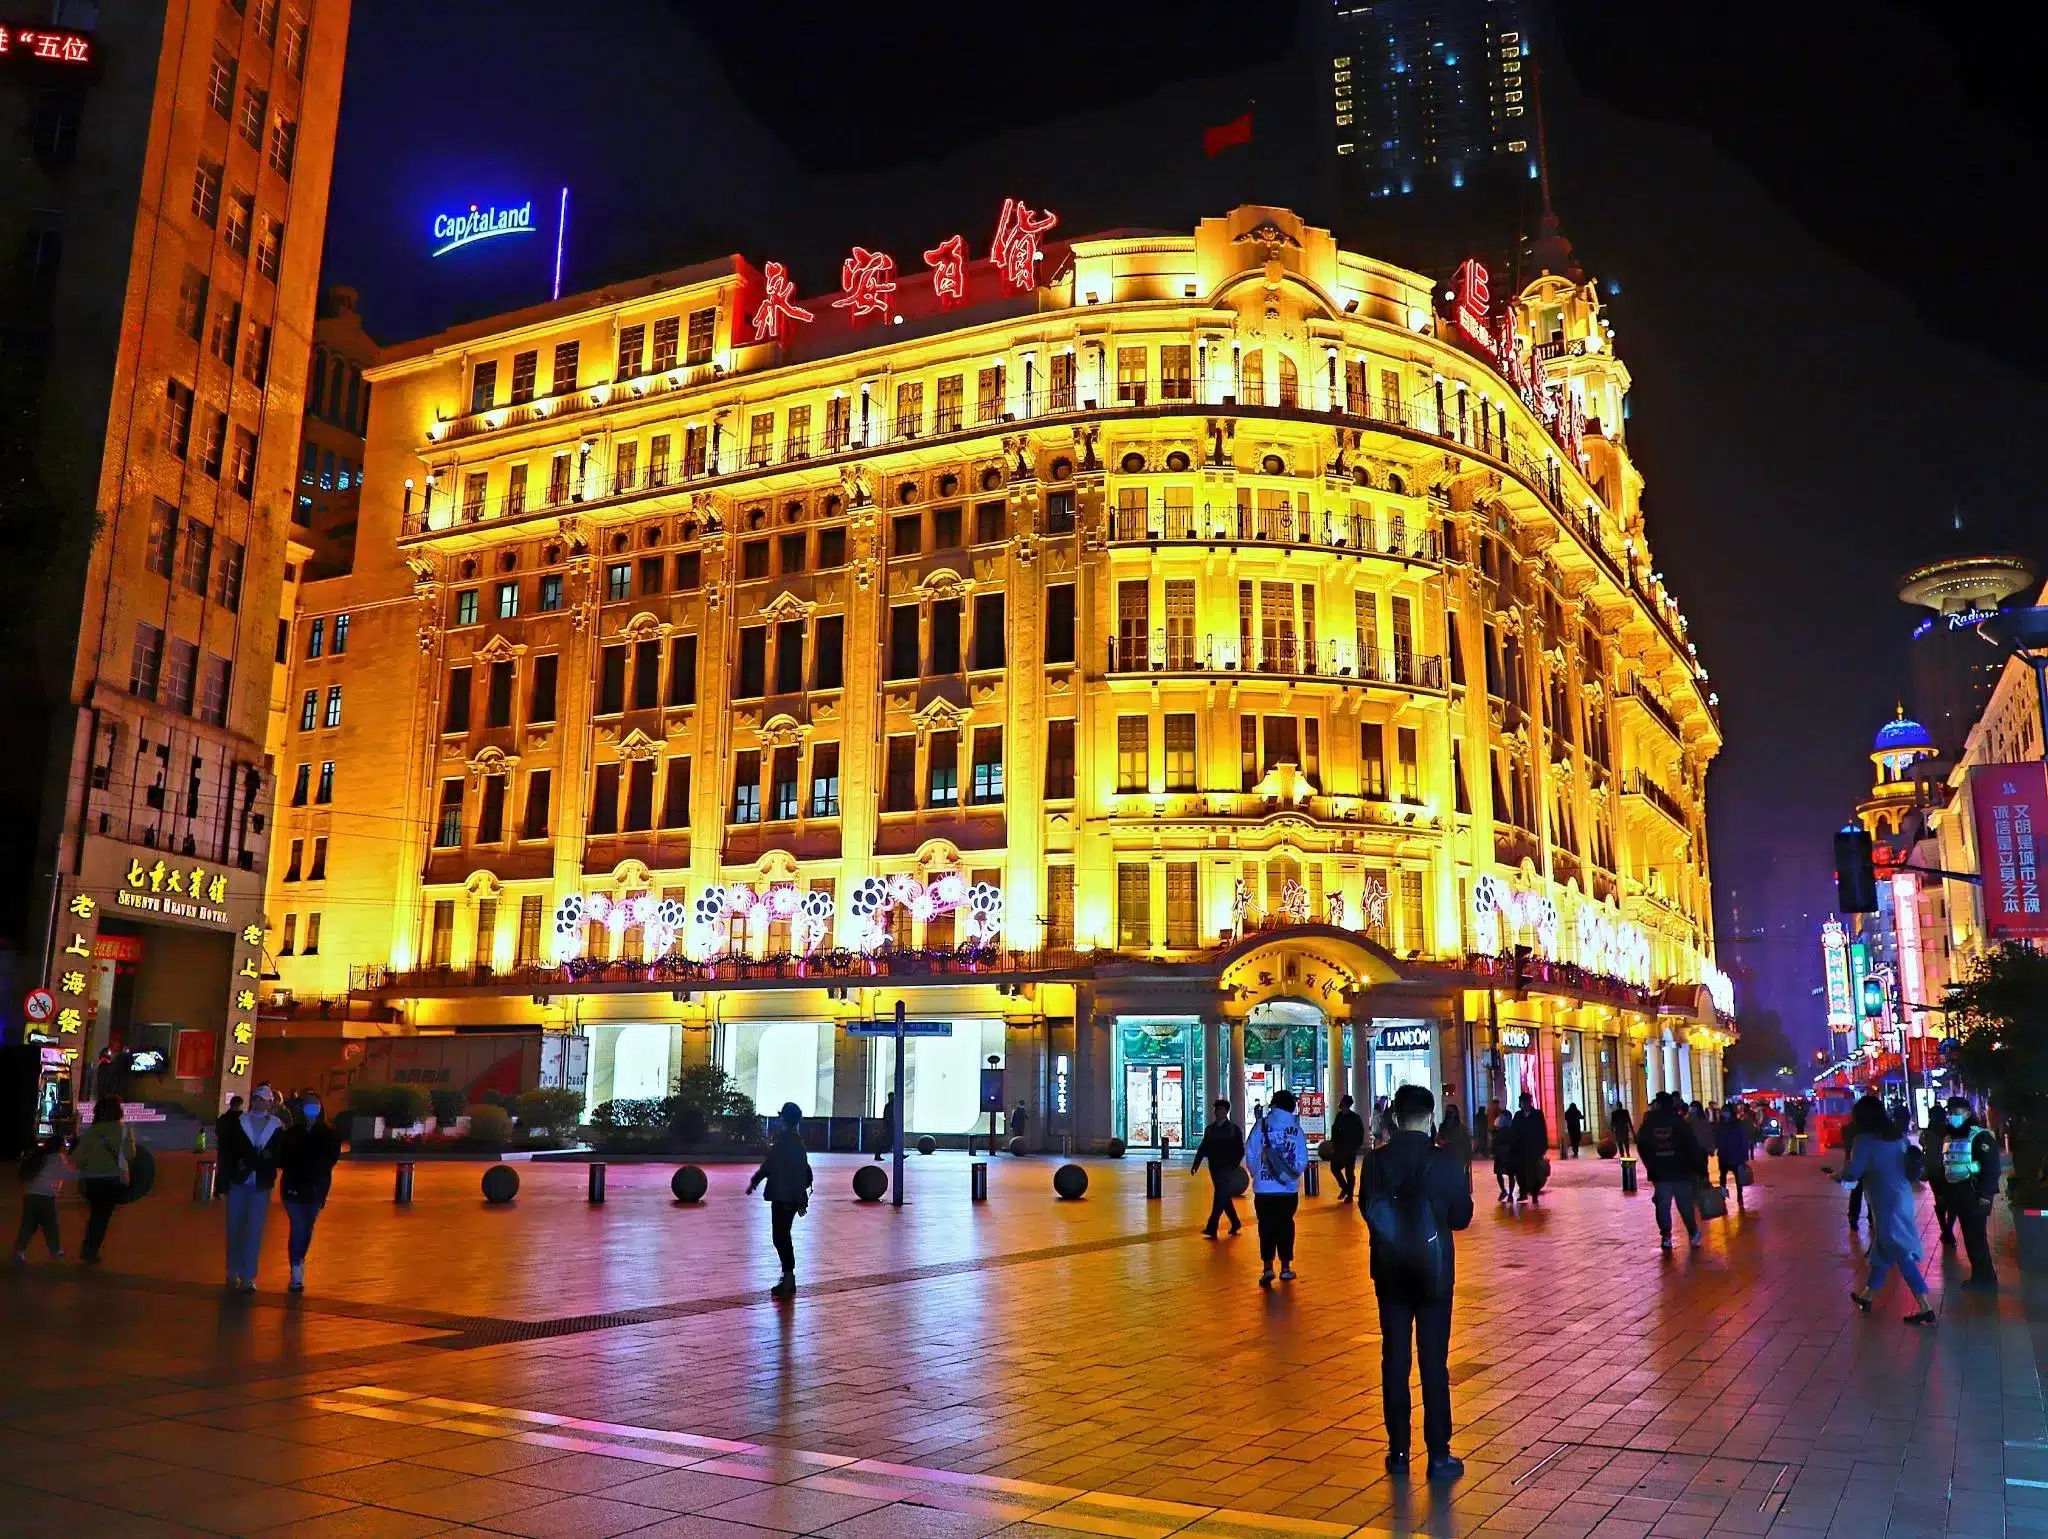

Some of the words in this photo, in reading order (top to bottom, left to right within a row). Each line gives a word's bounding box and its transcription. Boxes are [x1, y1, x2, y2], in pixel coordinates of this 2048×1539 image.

[434, 201, 531, 241] CapitaLand
[163, 898, 197, 918] HEAVEN
[199, 906, 228, 923] HOTEL
[230, 924, 262, 1076] 老上海餐厅
[1386, 1027, 1431, 1047] LANCÔM
